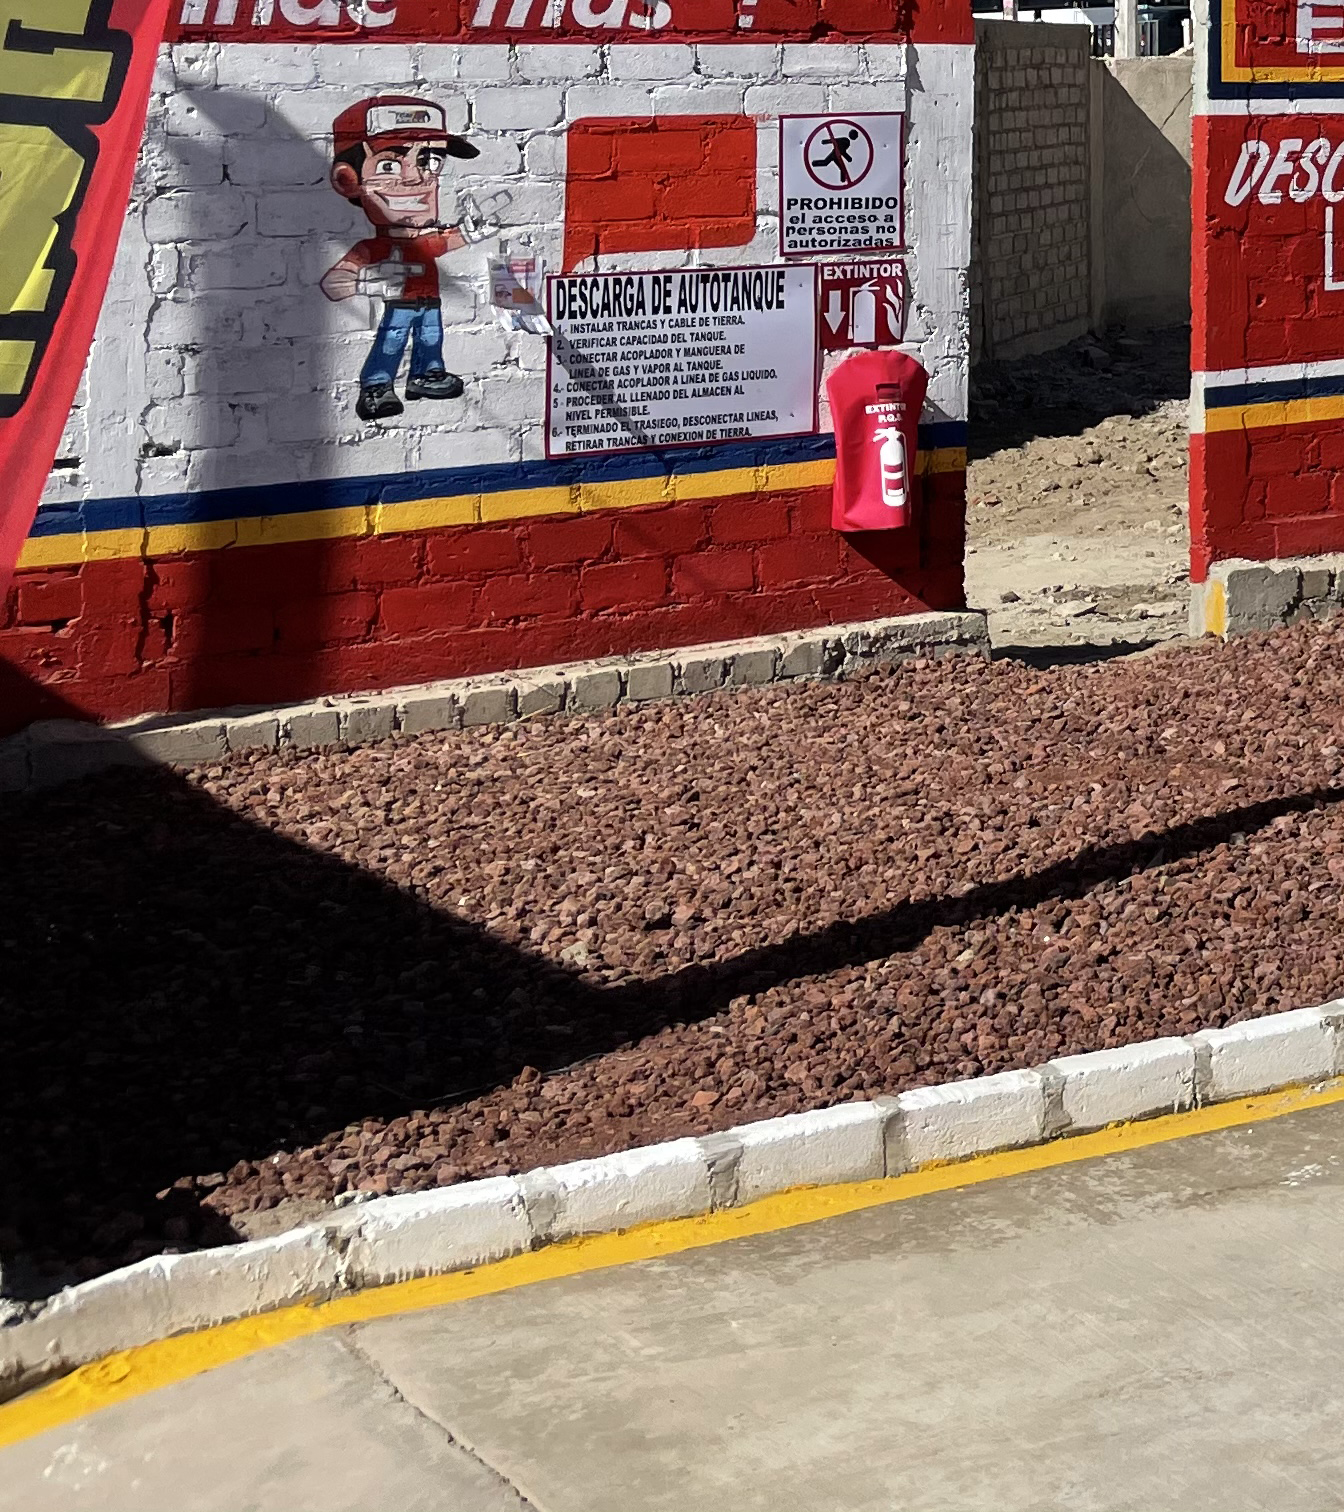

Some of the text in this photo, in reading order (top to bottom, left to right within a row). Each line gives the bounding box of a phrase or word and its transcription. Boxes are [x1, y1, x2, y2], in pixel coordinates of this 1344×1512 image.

[786, 196, 898, 211] PROHIBIDO
[788, 212, 894, 225] el acceso a
[785, 224, 897, 239] personas no
[787, 236, 894, 250] autorizadas
[823, 263, 903, 281] EXTINTOR
[556, 276, 645, 320] DESCARGA
[651, 275, 672, 316] DE
[678, 271, 784, 314] AUTOTANQUE
[570, 322, 613, 335] INSTALAR
[617, 320, 657, 332] TRANCAS
[668, 318, 696, 330] CABLE
[698, 317, 709, 328] DE
[568, 337, 617, 350] VERIFICAR
[619, 334, 668, 347] CAPACIDAD
[671, 334, 686, 344] DEL
[568, 352, 617, 365] CONECTAR
[620, 349, 672, 362] ACOPLADOR
[683, 345, 731, 358] MANGUERA
[734, 345, 745, 355] DE
[568, 367, 597, 379] LINEA
[597, 366, 609, 378] DE
[612, 365, 630, 377] GAS
[642, 363, 670, 375] VAPOR
[673, 362, 682, 373] AL
[566, 379, 614, 393] CONECTAR
[617, 376, 670, 390] ACOPLADOR
[681, 374, 706, 386] LINEA
[708, 373, 719, 384] DE
[722, 372, 739, 383] GAS
[566, 394, 615, 408] PROCEDER
[615, 394, 626, 405] AL
[630, 391, 670, 404] LLENADO
[672, 390, 688, 401] DEL
[691, 387, 731, 400] ALMACEN
[734, 387, 744, 397] AL
[565, 409, 590, 421] NIVEL
[565, 422, 618, 436] TERMINADO
[632, 420, 681, 432] EL
[682, 413, 744, 428] DESCONECTAR
[565, 439, 603, 452] RETIRAR
[607, 435, 650, 449] TRANCAS
[658, 432, 703, 445] CONEXION
[705, 431, 717, 441] DE
